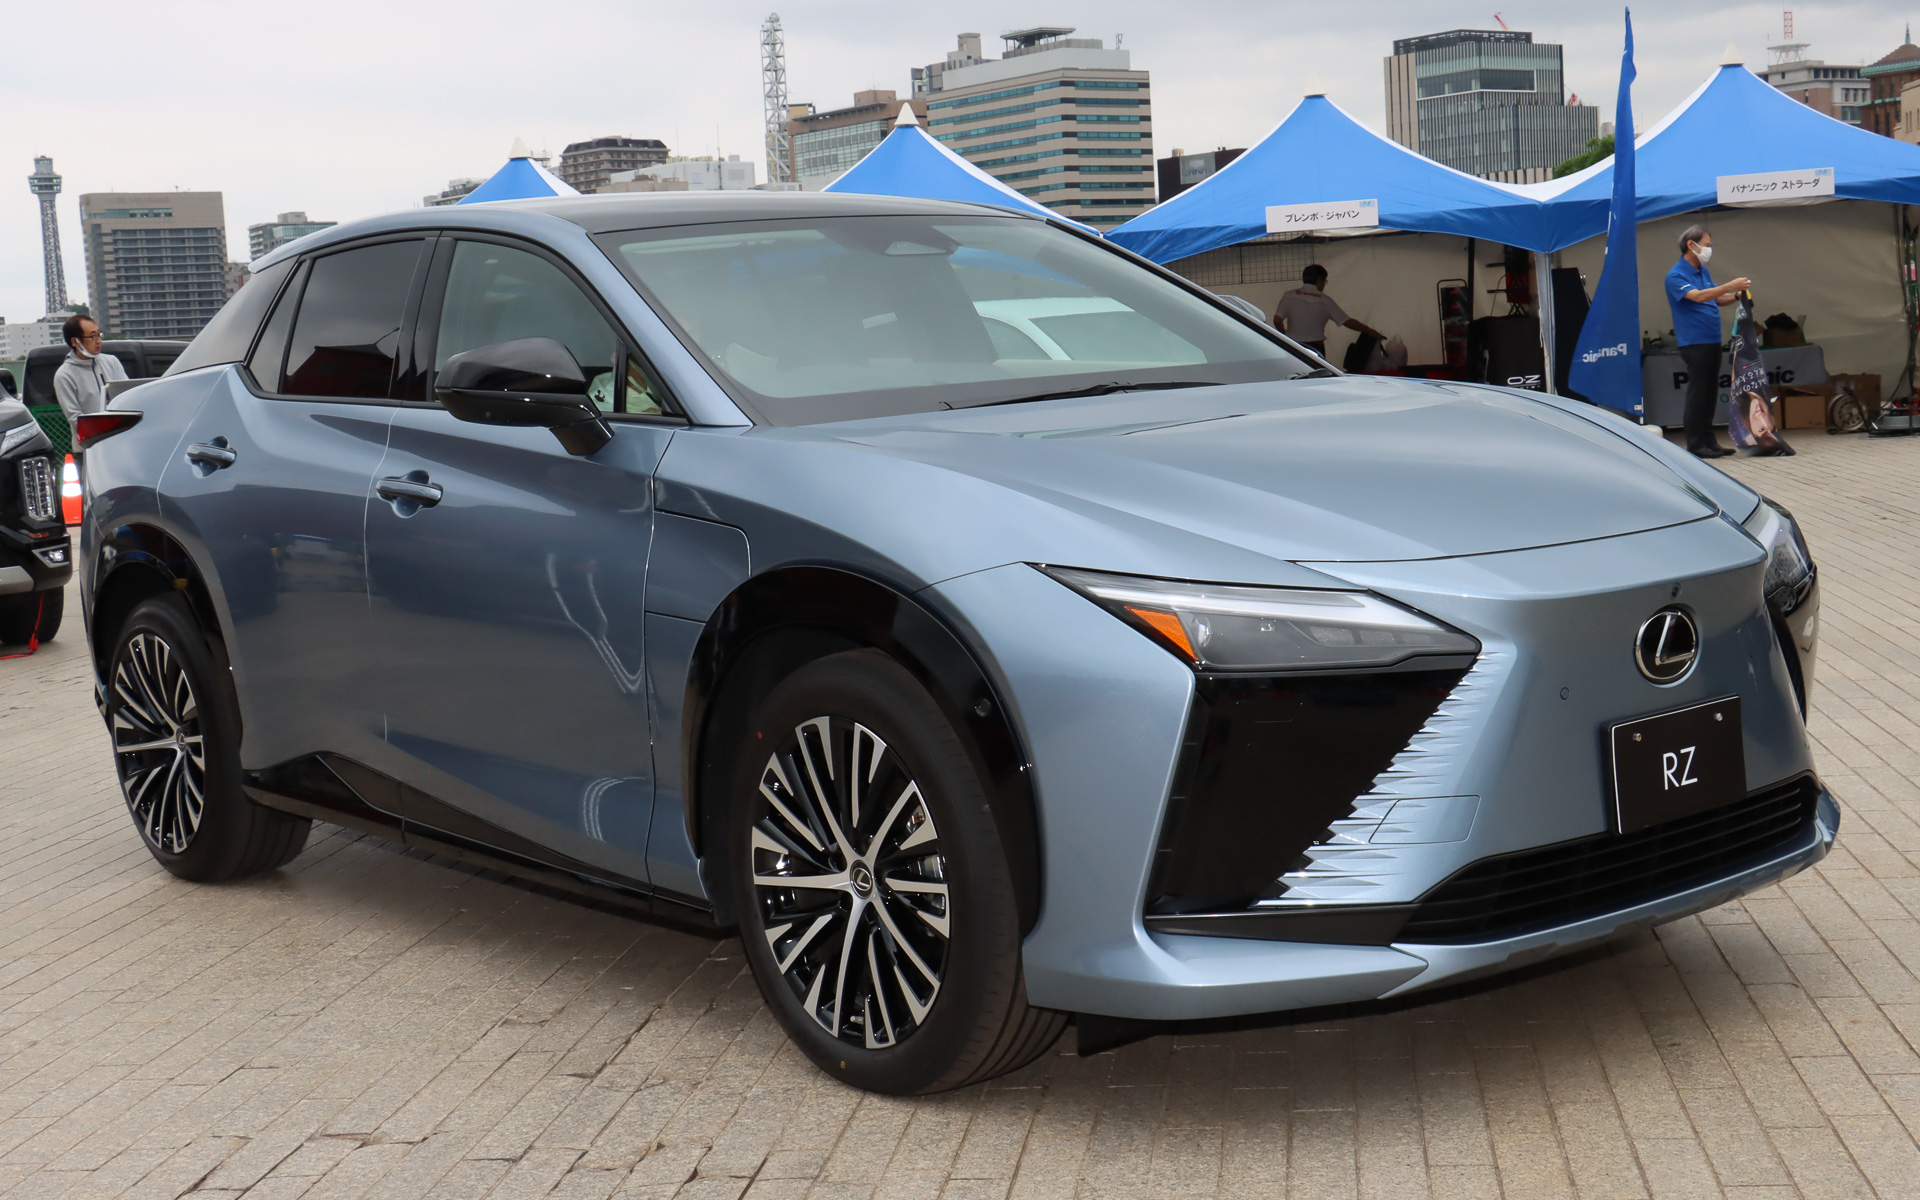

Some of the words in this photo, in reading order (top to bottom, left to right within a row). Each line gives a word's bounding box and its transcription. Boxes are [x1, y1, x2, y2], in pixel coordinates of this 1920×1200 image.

[1731, 182, 1778, 193] パナソニック
[1781, 178, 1820, 190] ストラーダ
[1662, 746, 1698, 790] RZ
